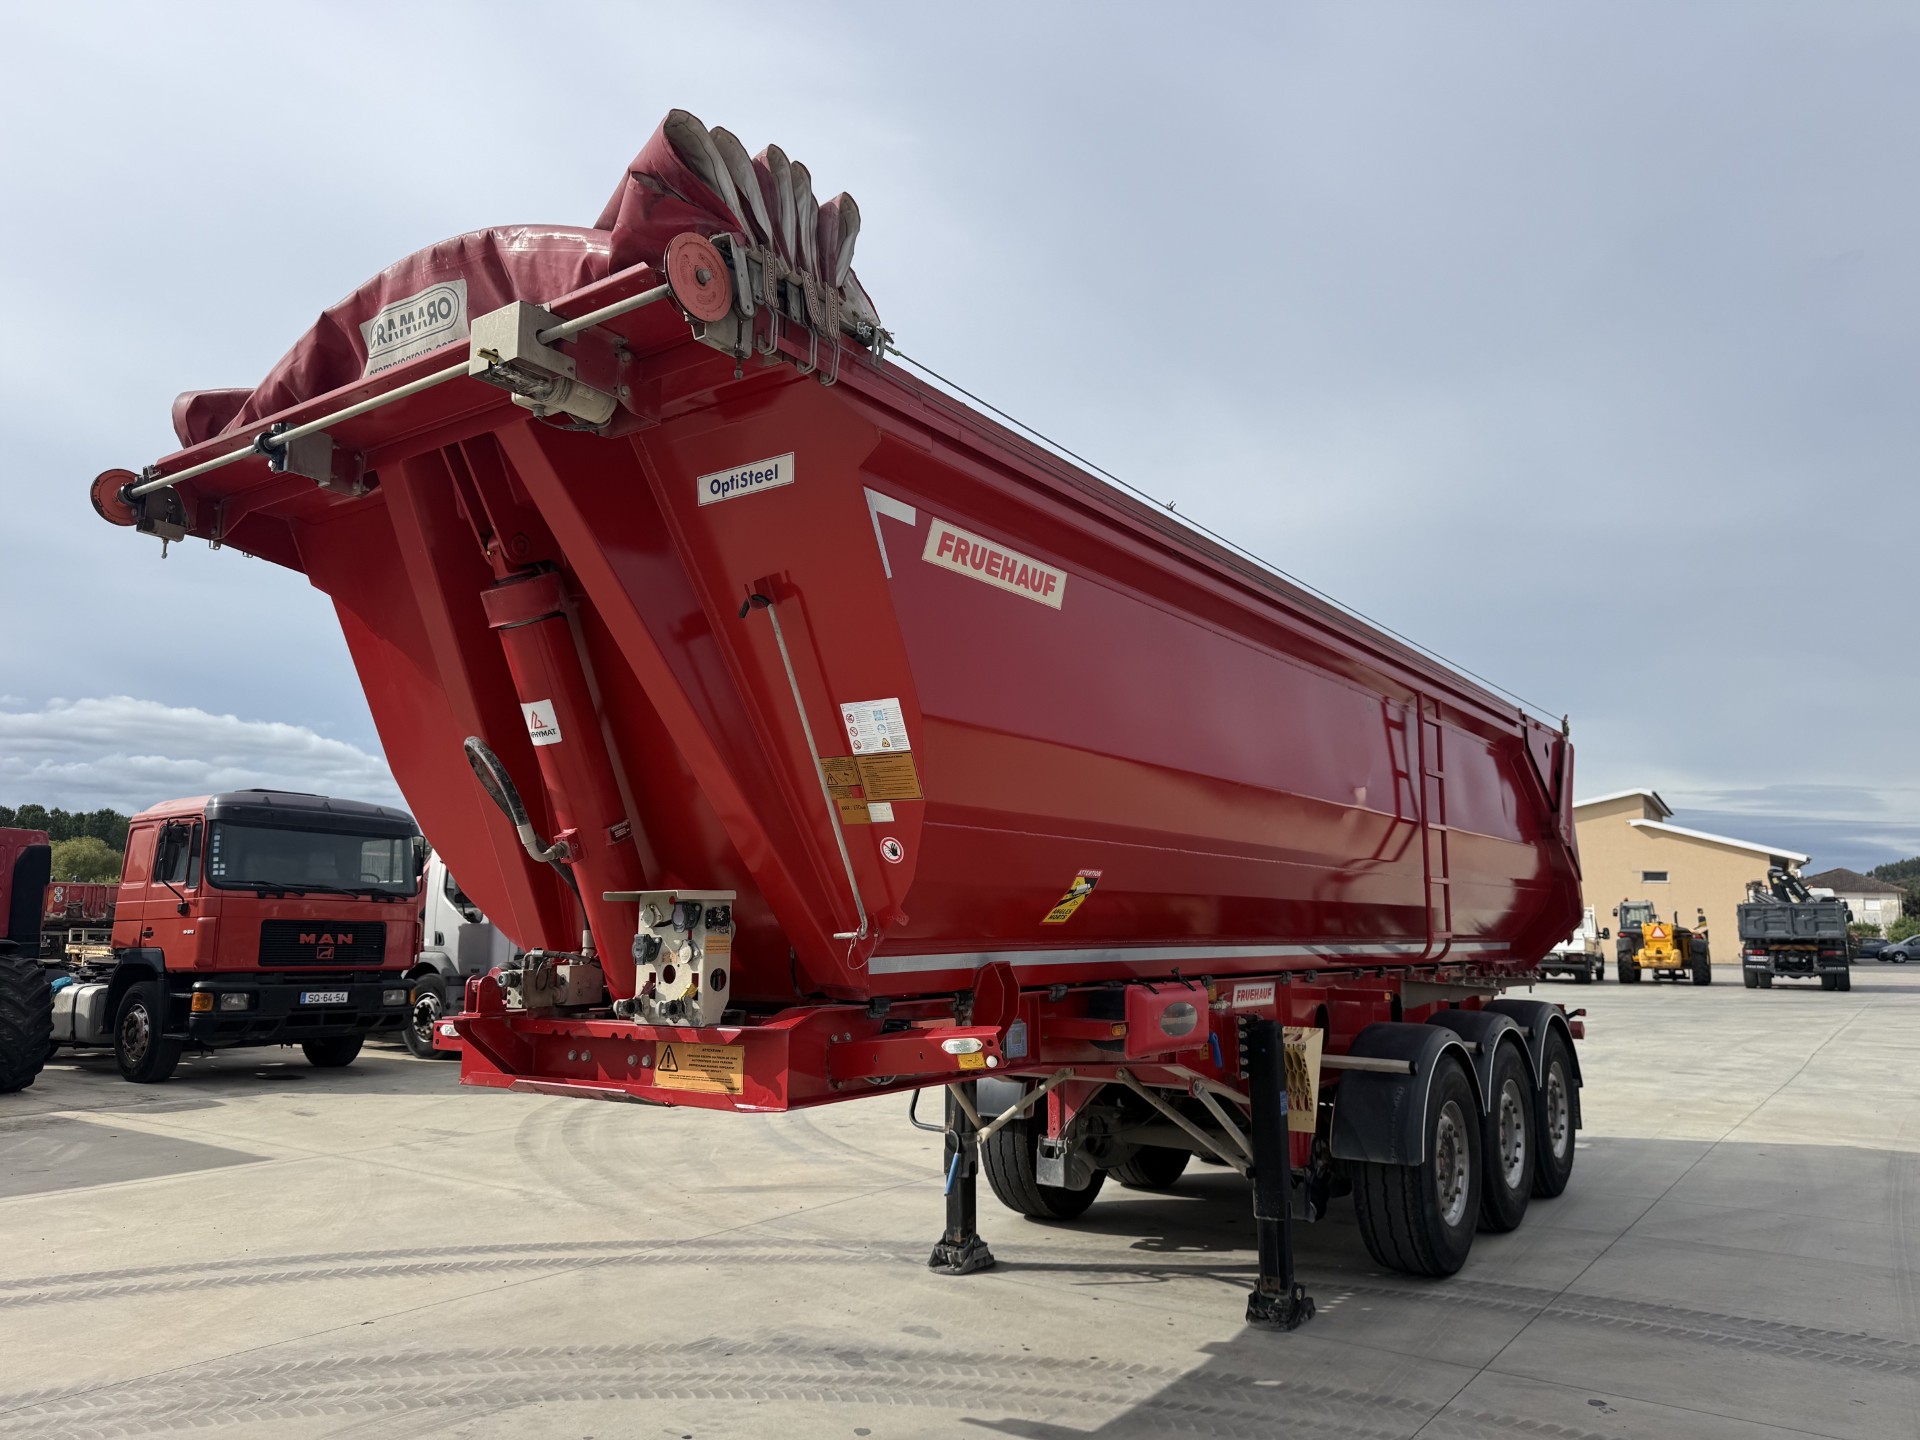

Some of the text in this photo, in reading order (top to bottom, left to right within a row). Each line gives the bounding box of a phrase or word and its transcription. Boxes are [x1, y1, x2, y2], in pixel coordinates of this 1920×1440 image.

[710, 463, 779, 497] OptiSteel
[936, 531, 1057, 597] FRUEHAUF
[299, 933, 353, 945] MAN
[1236, 987, 1272, 1002] FRUEHAUF
